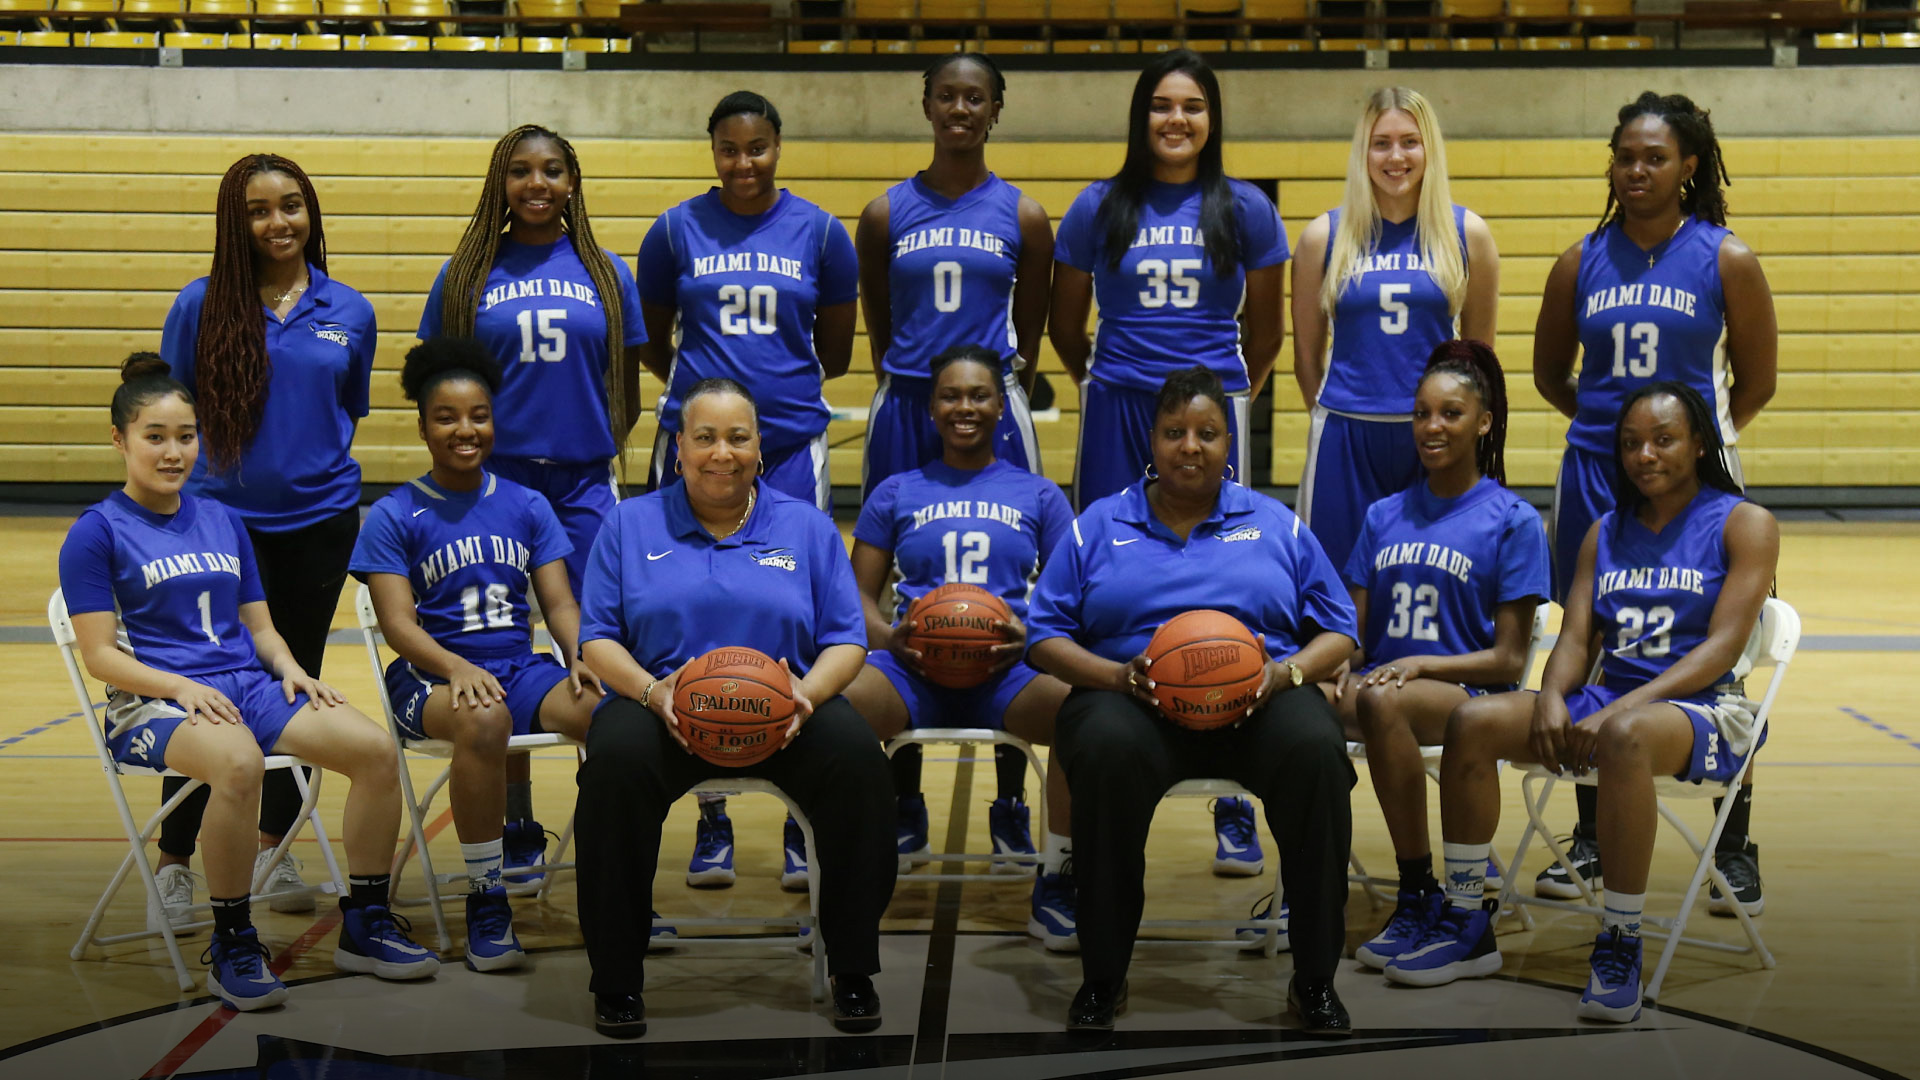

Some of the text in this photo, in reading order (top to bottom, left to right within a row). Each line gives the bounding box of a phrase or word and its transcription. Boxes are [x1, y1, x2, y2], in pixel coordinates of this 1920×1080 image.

[896, 227, 1004, 258] MIAMI DADE
[1129, 226, 1205, 248] AMI DA
[694, 252, 802, 280] MIAMI DADE
[933, 261, 962, 312] 0
[1136, 259, 1203, 308] 35
[485, 279, 596, 310] MIAMI DADE
[718, 284, 777, 336] 20
[1379, 283, 1411, 335] 5
[1586, 283, 1697, 319] MIAMI DADE
[516, 309, 568, 362] 15
[1611, 321, 1659, 378] 13
[913, 501, 1022, 532] MIAMI DADE
[141, 552, 241, 590] MIAMI DAD
[420, 535, 484, 590] MIAMI
[942, 531, 990, 584] 12
[1375, 542, 1473, 584] MIAMI DADE
[1597, 567, 1704, 600] MIAMI DADE
[197, 590, 221, 647] 1
[924, 615, 997, 634] SPALDING
[1387, 582, 1439, 641] 32
[1612, 605, 1676, 658] 23
[689, 692, 771, 718] SPALDING
[688, 723, 767, 747] TF 1000
